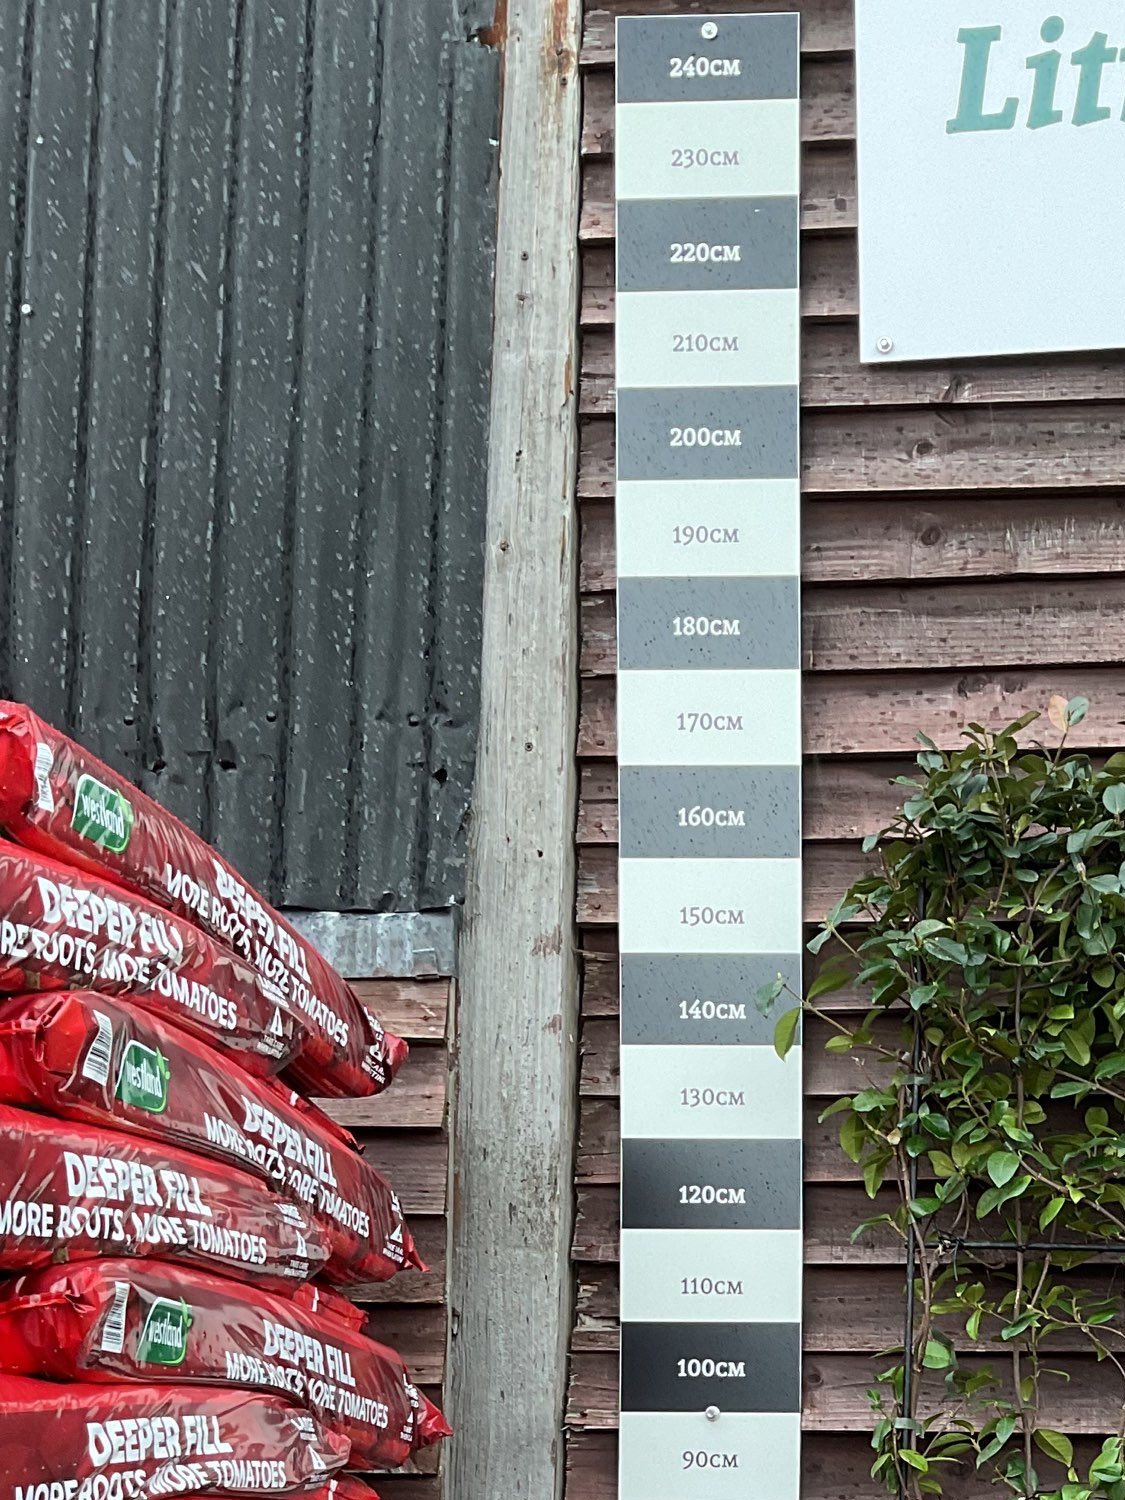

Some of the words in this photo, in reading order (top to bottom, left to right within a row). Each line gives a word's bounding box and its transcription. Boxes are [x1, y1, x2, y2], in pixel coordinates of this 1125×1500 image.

[37, 876, 136, 949] DEEPER
[272, 924, 313, 985] FILL
[150, 961, 238, 1031] TOMATOES
[291, 976, 349, 1048] TOMATOES
[204, 1111, 246, 1155] MORE
[305, 1138, 337, 1188] FILL
[63, 1151, 164, 1207] DEEPER
[160, 1168, 212, 1217] FILL
[57, 1205, 131, 1245] ROOTS,
[131, 1211, 188, 1245] MORE
[187, 1218, 267, 1265] TOMATOES
[263, 1318, 325, 1376] DEEPER
[325, 1344, 356, 1387] FILL
[225, 1350, 266, 1385] MORE
[337, 1388, 389, 1429] TOMATOES
[86, 1417, 180, 1467] DEEPER
[181, 1415, 233, 1455] FILL
[149, 1463, 210, 1495] MORE
[213, 1460, 287, 1489] TOMATOES
